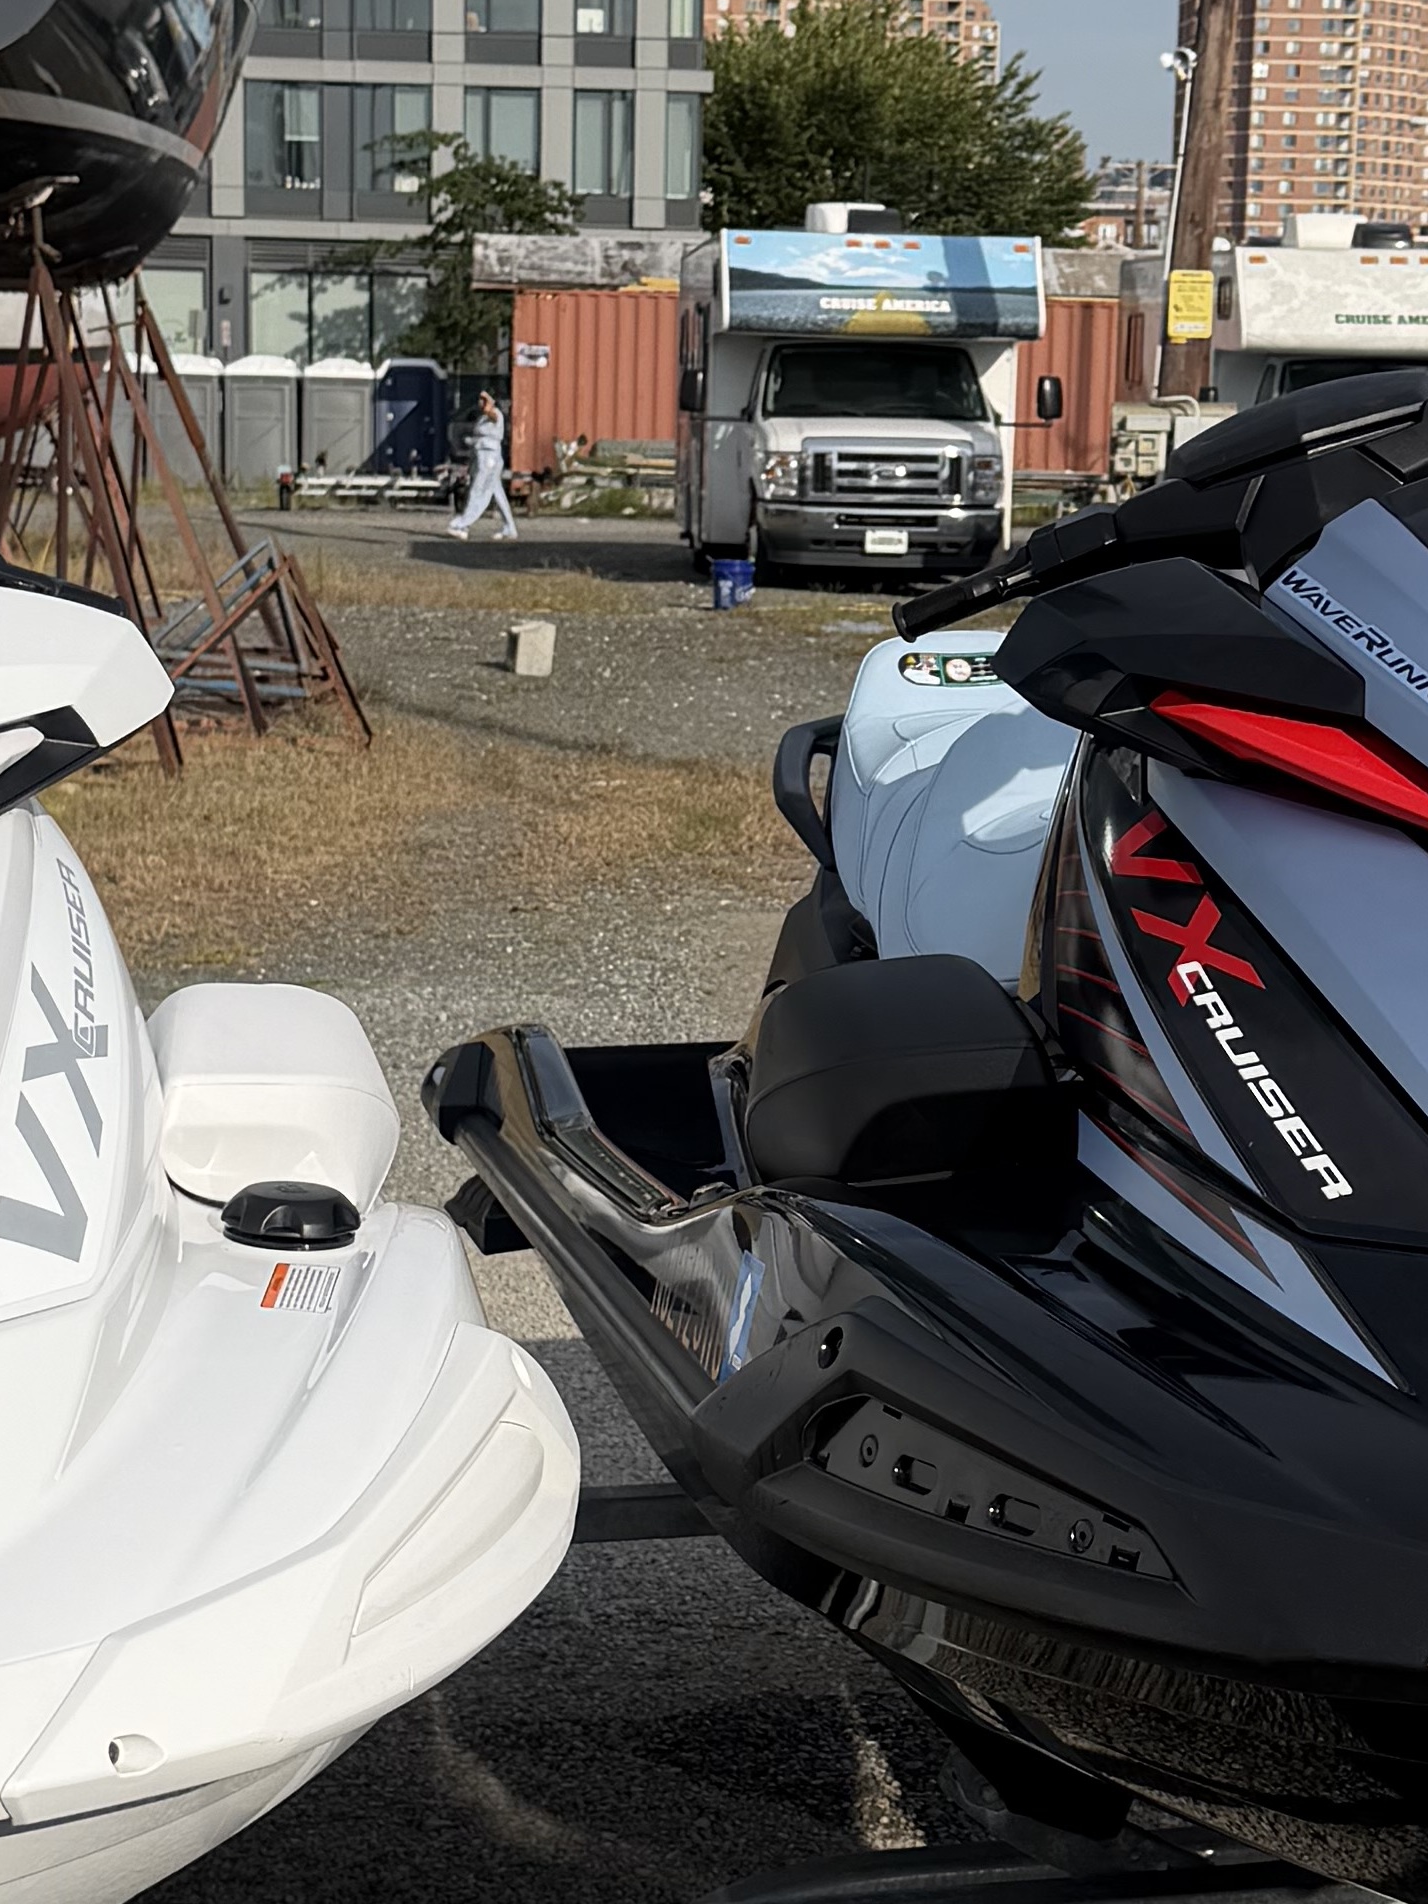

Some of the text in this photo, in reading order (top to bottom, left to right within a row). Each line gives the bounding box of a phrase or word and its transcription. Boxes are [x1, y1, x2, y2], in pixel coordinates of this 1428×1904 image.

[819, 297, 952, 313] CRUISE AMERICA
[1334, 313, 1393, 325] CRUISE
[56, 857, 97, 1058] CRUISER
[1111, 809, 1267, 1008] VX
[1176, 961, 1354, 1201] CRUISER
